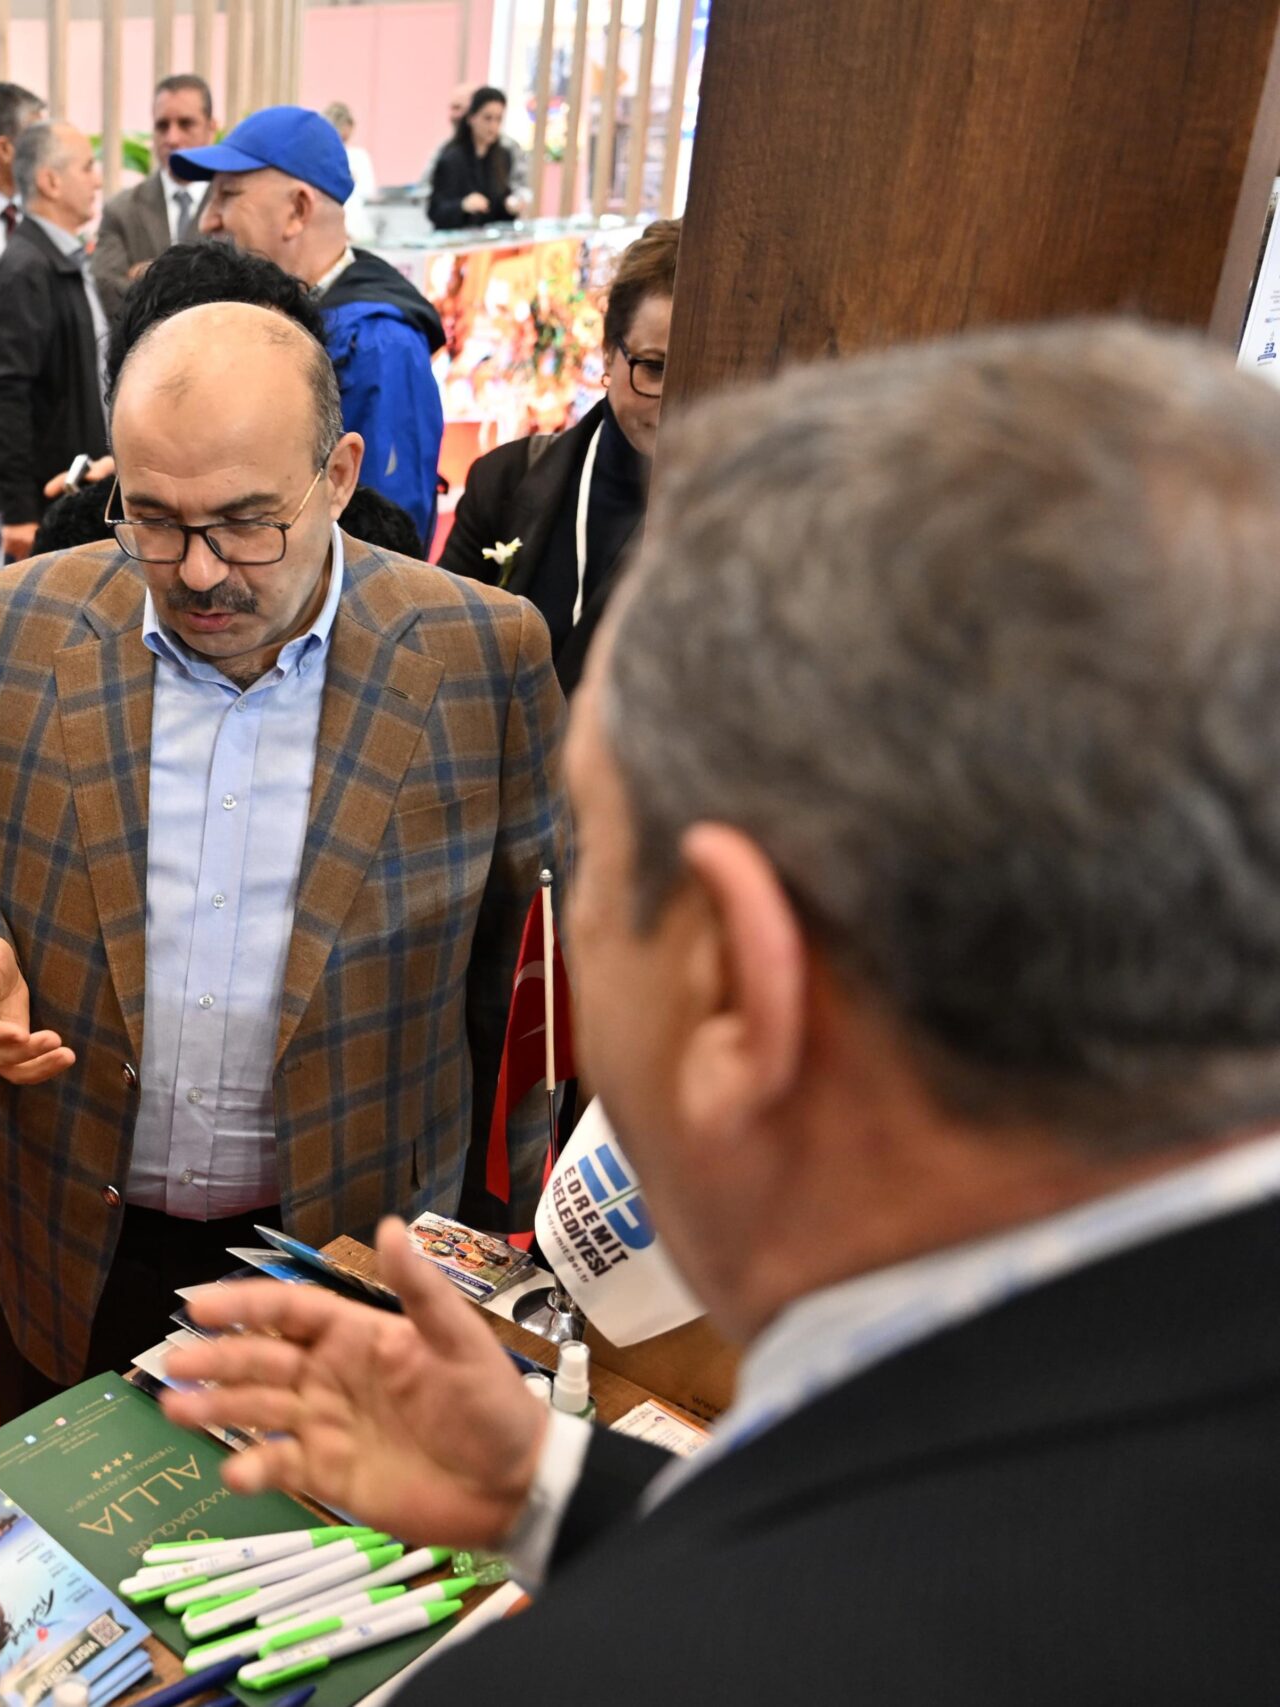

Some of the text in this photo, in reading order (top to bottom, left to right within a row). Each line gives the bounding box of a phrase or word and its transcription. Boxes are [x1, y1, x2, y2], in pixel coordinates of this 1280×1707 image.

[553, 1175, 613, 1278] BELEDİYESİ
[564, 1165, 629, 1264] EDREMİT
[79, 1453, 201, 1536] ALLIA
[71, 1639, 101, 1666] VISIT
